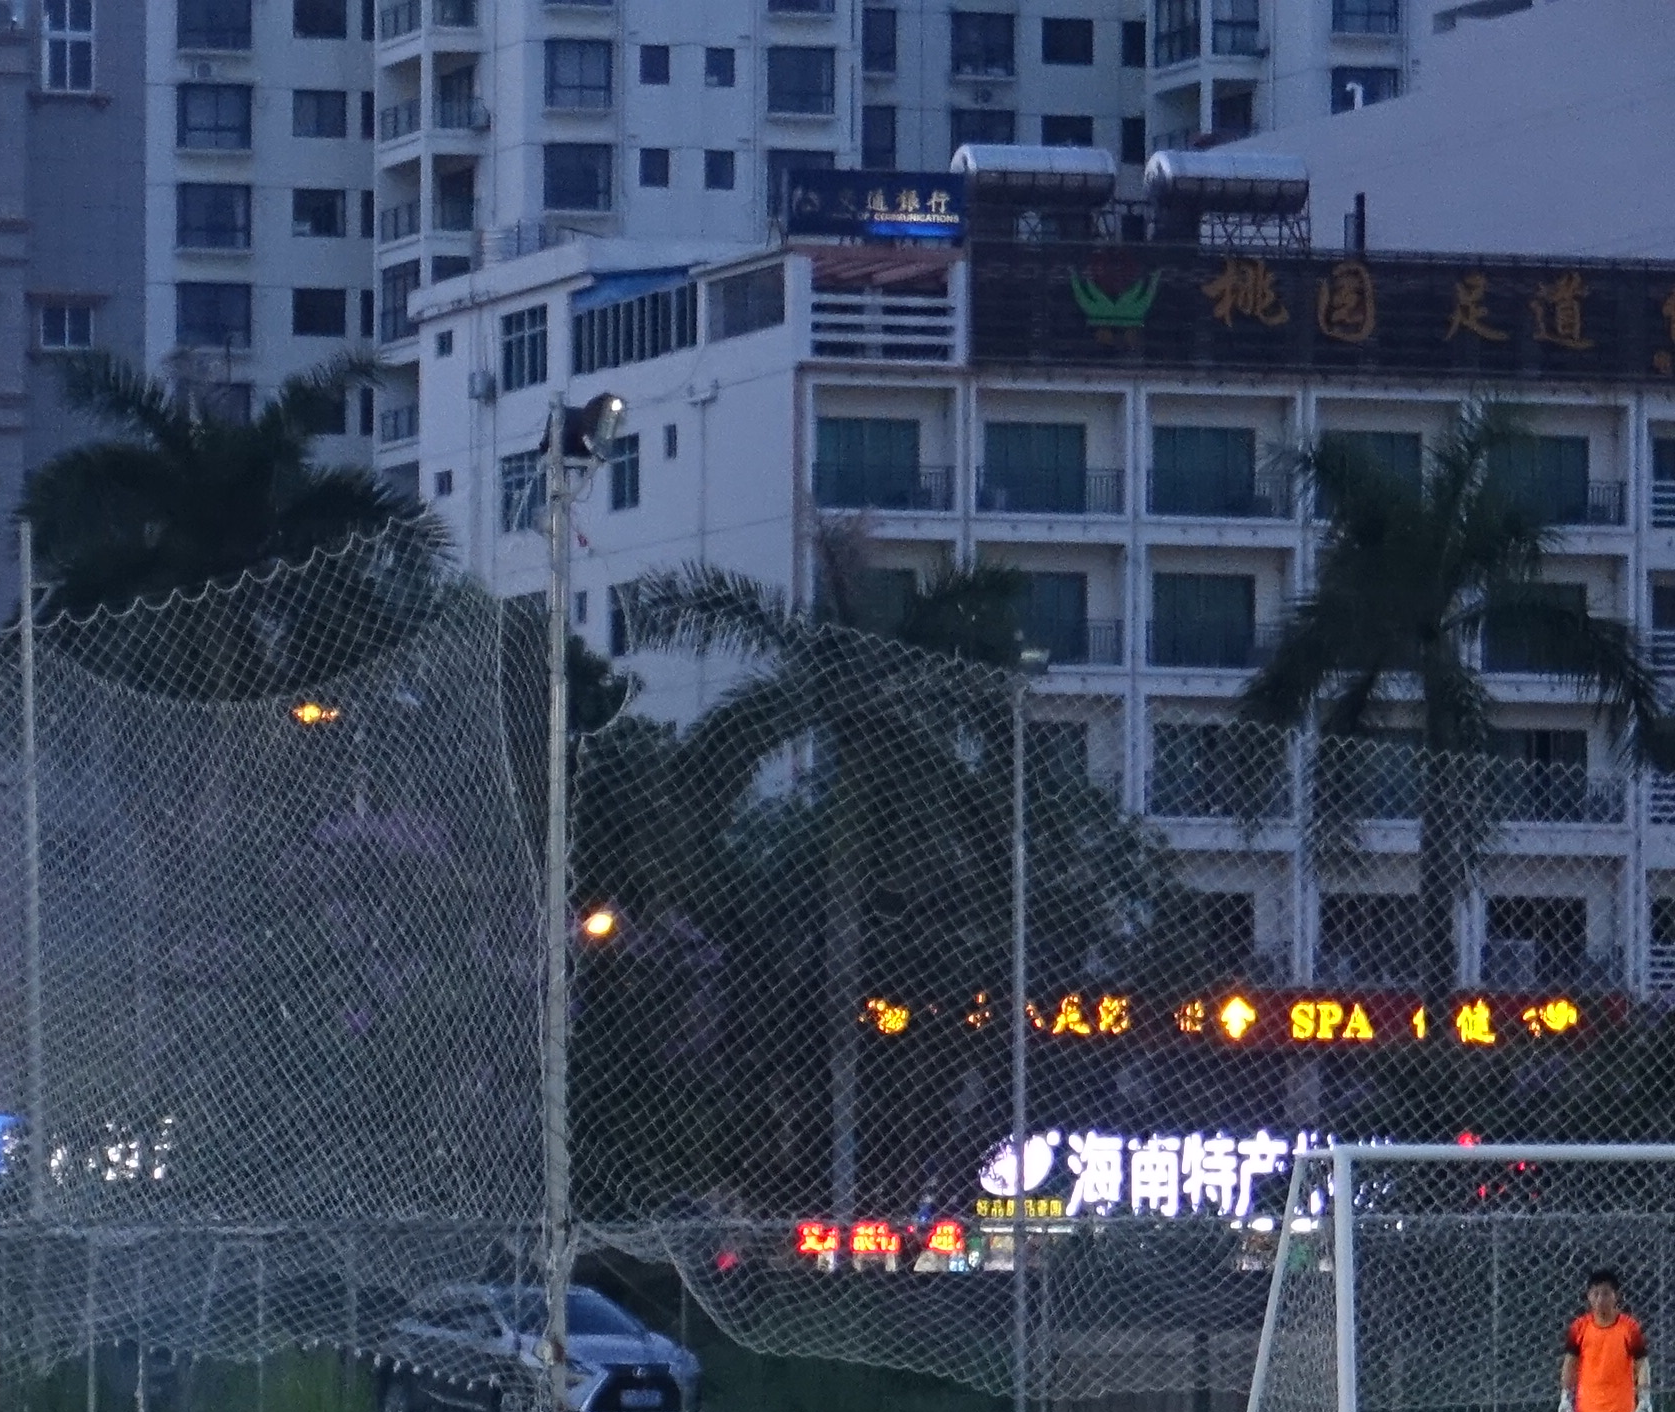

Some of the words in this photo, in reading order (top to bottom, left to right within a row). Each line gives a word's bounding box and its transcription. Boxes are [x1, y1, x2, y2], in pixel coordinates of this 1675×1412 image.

[1290, 1002, 1373, 1041] SPA
[1065, 1129, 1401, 1217] 海南特产
